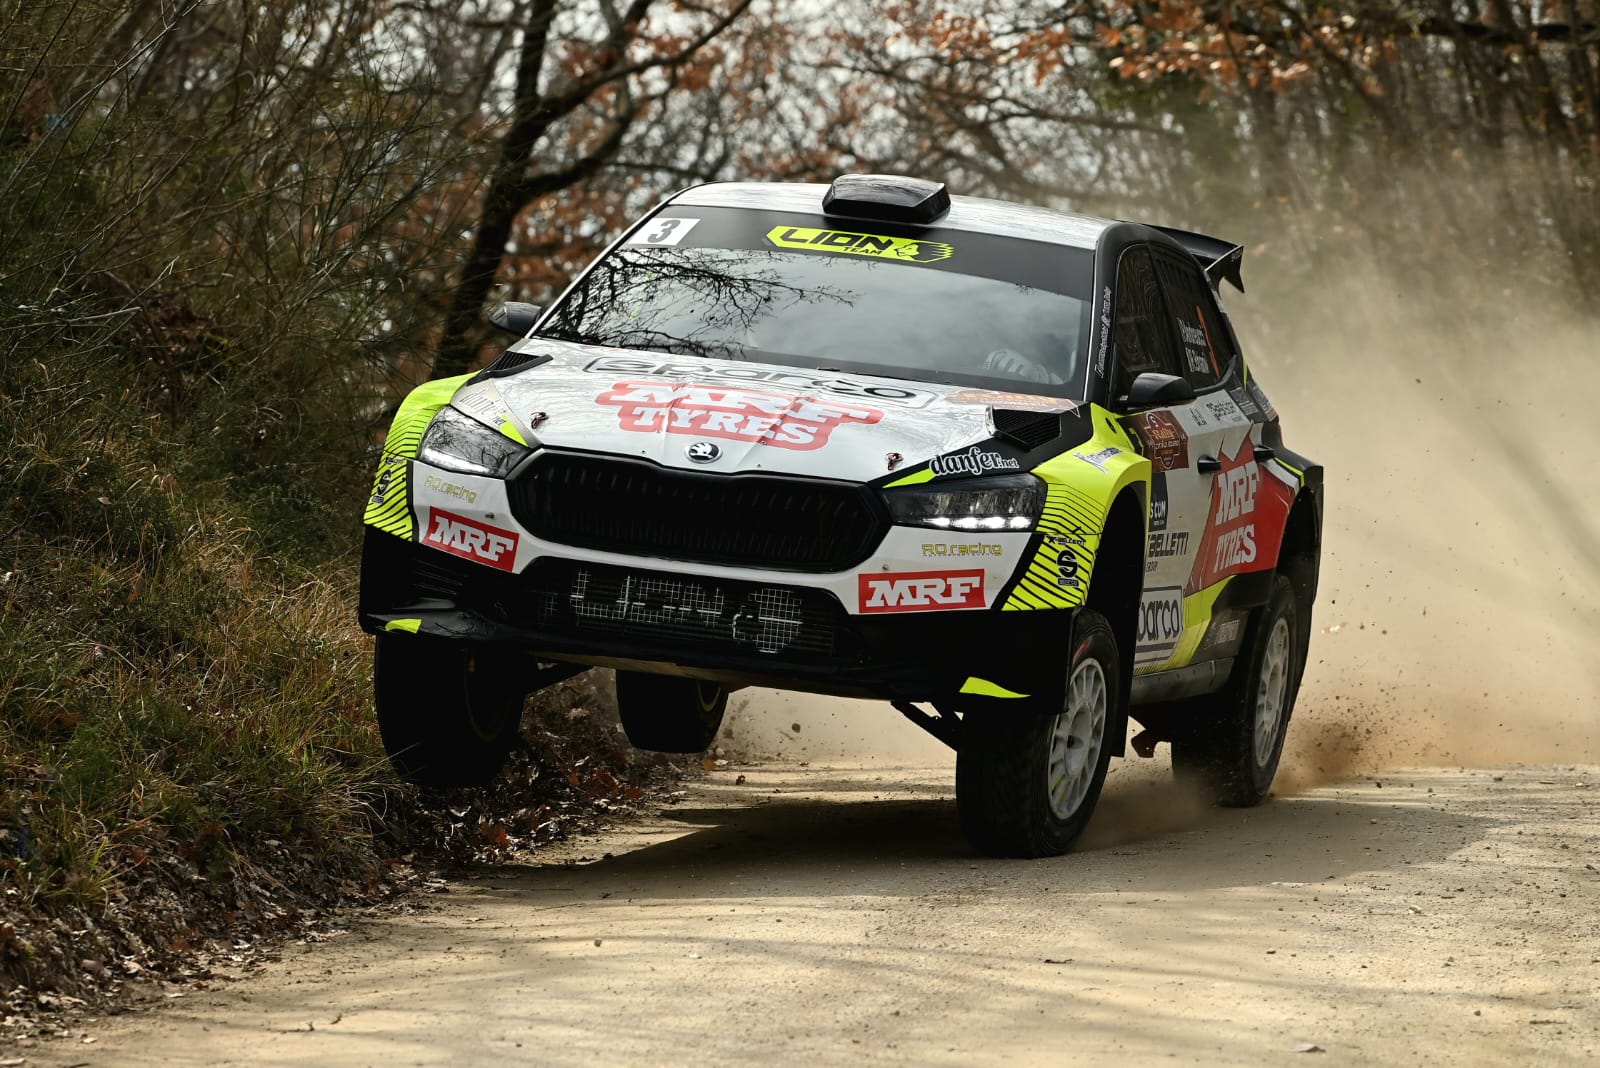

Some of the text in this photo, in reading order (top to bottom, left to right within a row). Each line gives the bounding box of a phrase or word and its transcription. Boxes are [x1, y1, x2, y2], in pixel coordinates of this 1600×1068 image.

[647, 219, 681, 243] 3
[779, 228, 893, 250] LION
[843, 246, 883, 255] TEAM
[609, 384, 870, 423] MRF
[632, 405, 818, 445] TYRES
[1215, 461, 1260, 526] MRF
[428, 515, 515, 562] MRF
[1148, 532, 1189, 557] BELLETTI
[1213, 524, 1257, 573] TYRES
[865, 576, 981, 607] MRF
[1137, 599, 1180, 642] parco
